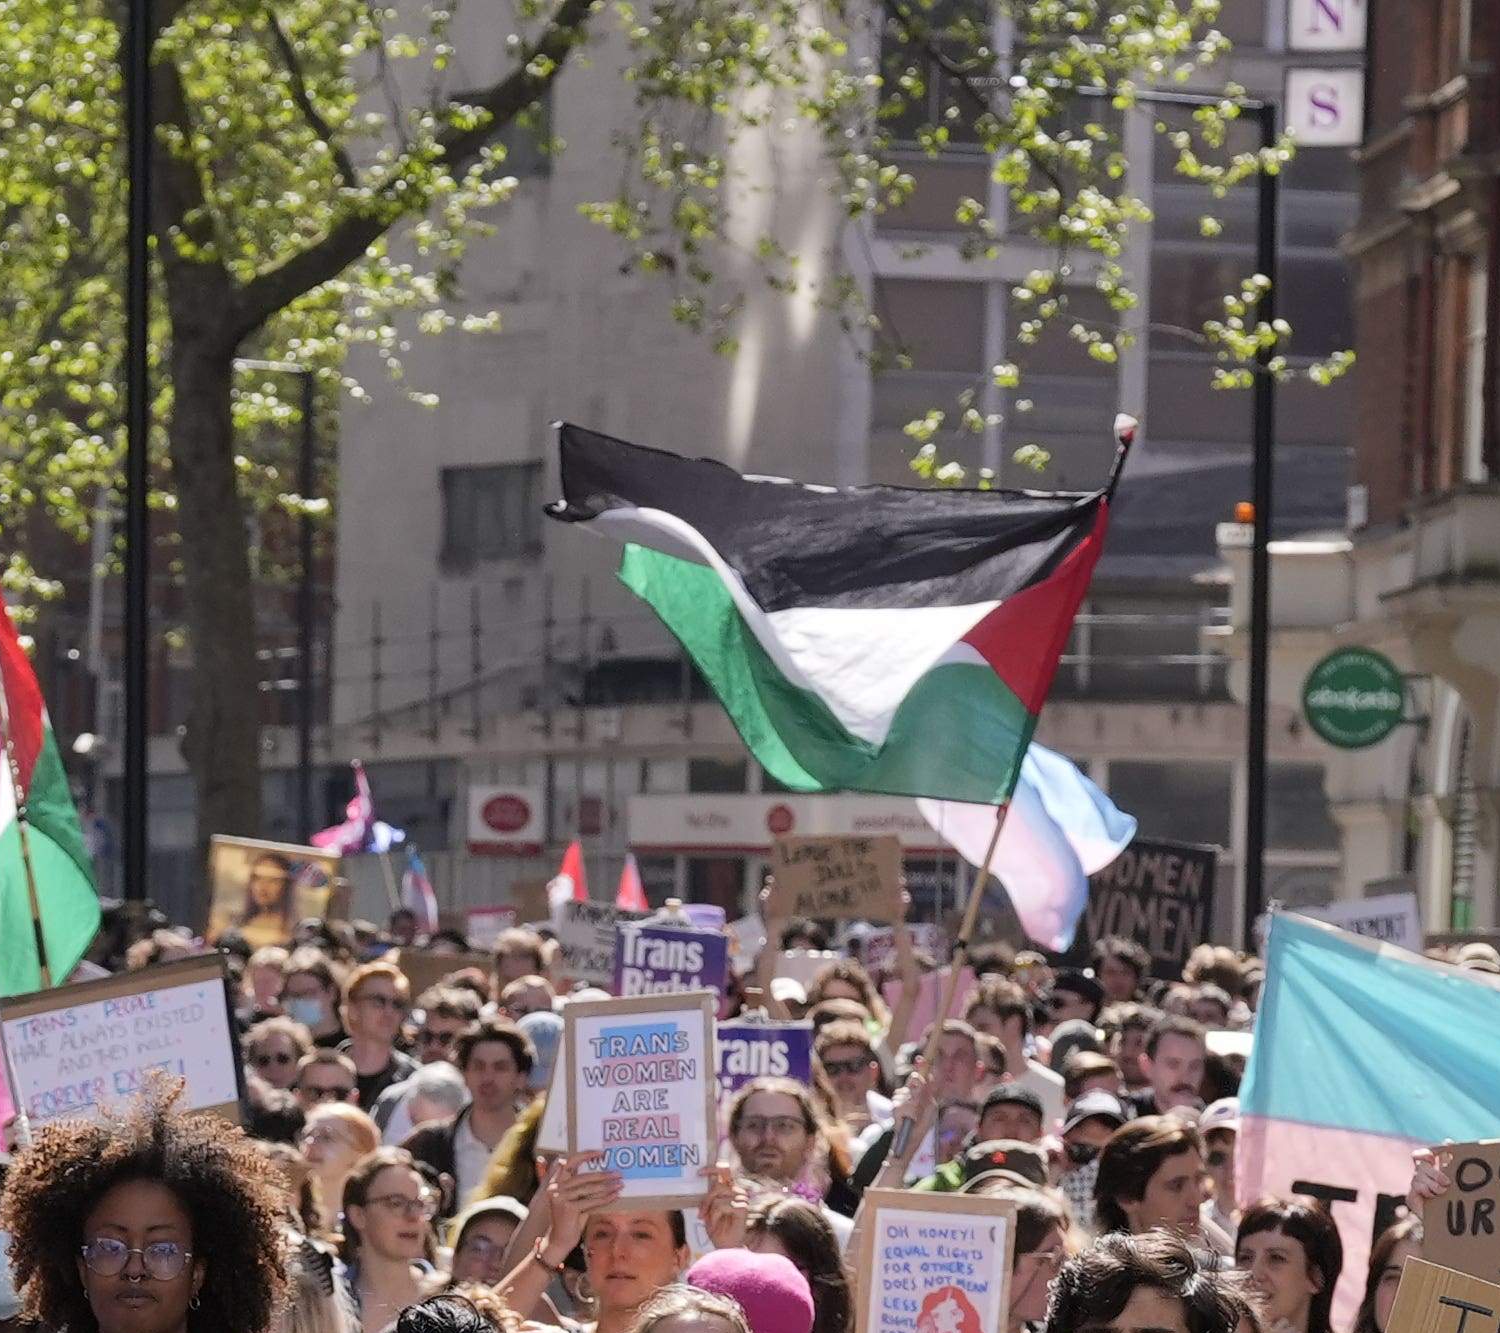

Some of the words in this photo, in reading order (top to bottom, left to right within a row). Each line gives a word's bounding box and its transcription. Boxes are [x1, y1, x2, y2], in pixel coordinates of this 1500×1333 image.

[619, 926, 705, 974] Trans
[15, 1009, 79, 1041] TRANS
[588, 1030, 691, 1059] TRANS
[716, 1038, 790, 1078] rans
[581, 1057, 698, 1089] WOMEN
[611, 1088, 670, 1114] ARE
[602, 1116, 680, 1142] REAL
[586, 1143, 701, 1172] WOMEN
[1446, 1197, 1497, 1237] UR
[885, 1225, 910, 1239] OH
[917, 1225, 976, 1242] HONEY!
[883, 1245, 931, 1260] EQUAL
[936, 1244, 985, 1261] RIGHTS
[882, 1261, 913, 1275] FOR
[919, 1260, 976, 1276] OTHERS
[882, 1277, 918, 1292] DOES
[923, 1274, 954, 1290] NOT
[955, 1277, 990, 1294] MEAN
[882, 1295, 919, 1312] LESS
